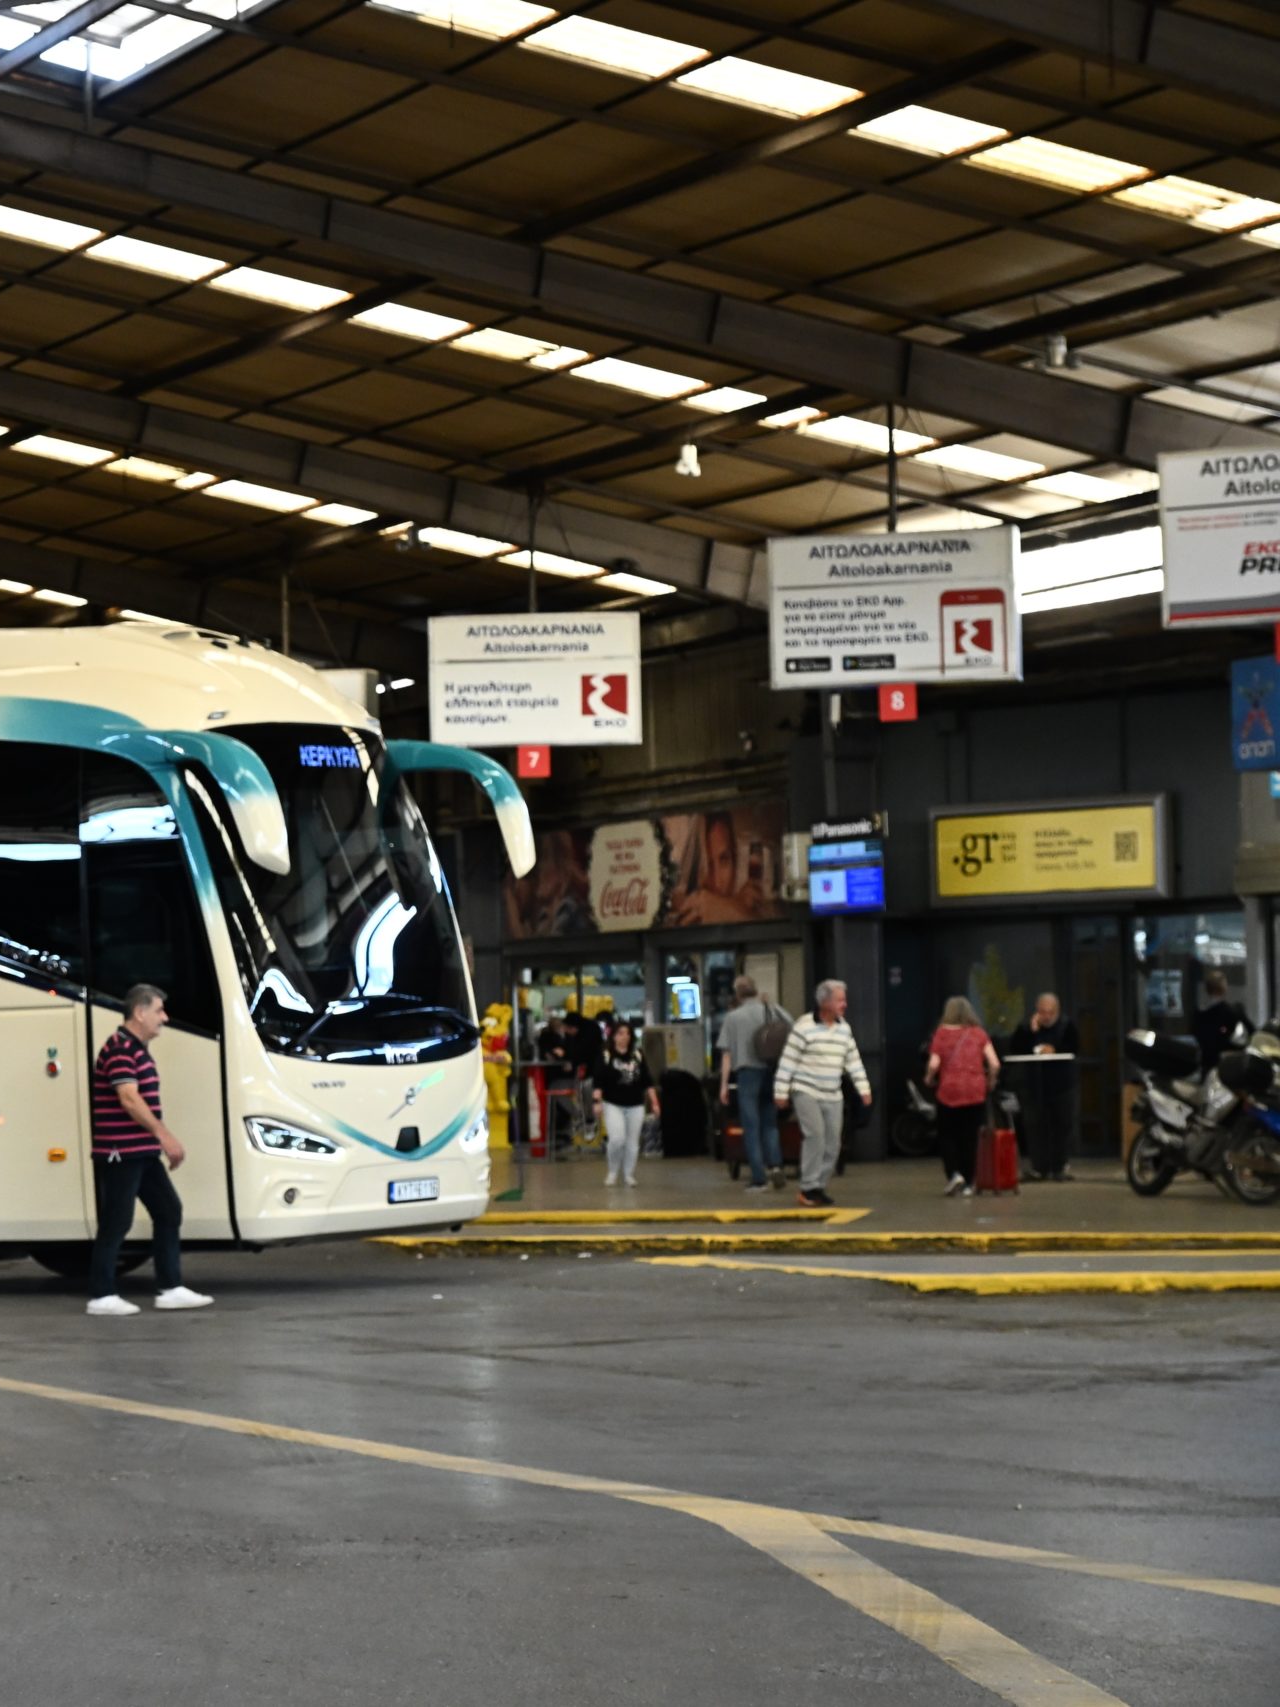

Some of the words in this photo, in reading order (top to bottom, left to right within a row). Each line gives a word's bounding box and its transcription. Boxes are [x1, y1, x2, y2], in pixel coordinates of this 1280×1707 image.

[1201, 454, 1280, 477] ΑΙΤΩΛΟ
[809, 539, 972, 559] ΑΙΤΩΛΟΑΚΑΡΝΑΝΙΑ
[829, 560, 953, 577] Aitoloakarnania
[1240, 556, 1280, 576] PR
[466, 623, 605, 637] ΑΙΤΩΛΟΑΚΑΡΝΑΝΙΑ
[483, 641, 590, 653] Aitoloakarnania
[890, 691, 905, 711] 8
[593, 719, 628, 728] EKO
[300, 744, 360, 768] ΚΕΡΚΥΡΑ
[527, 752, 540, 769] 7
